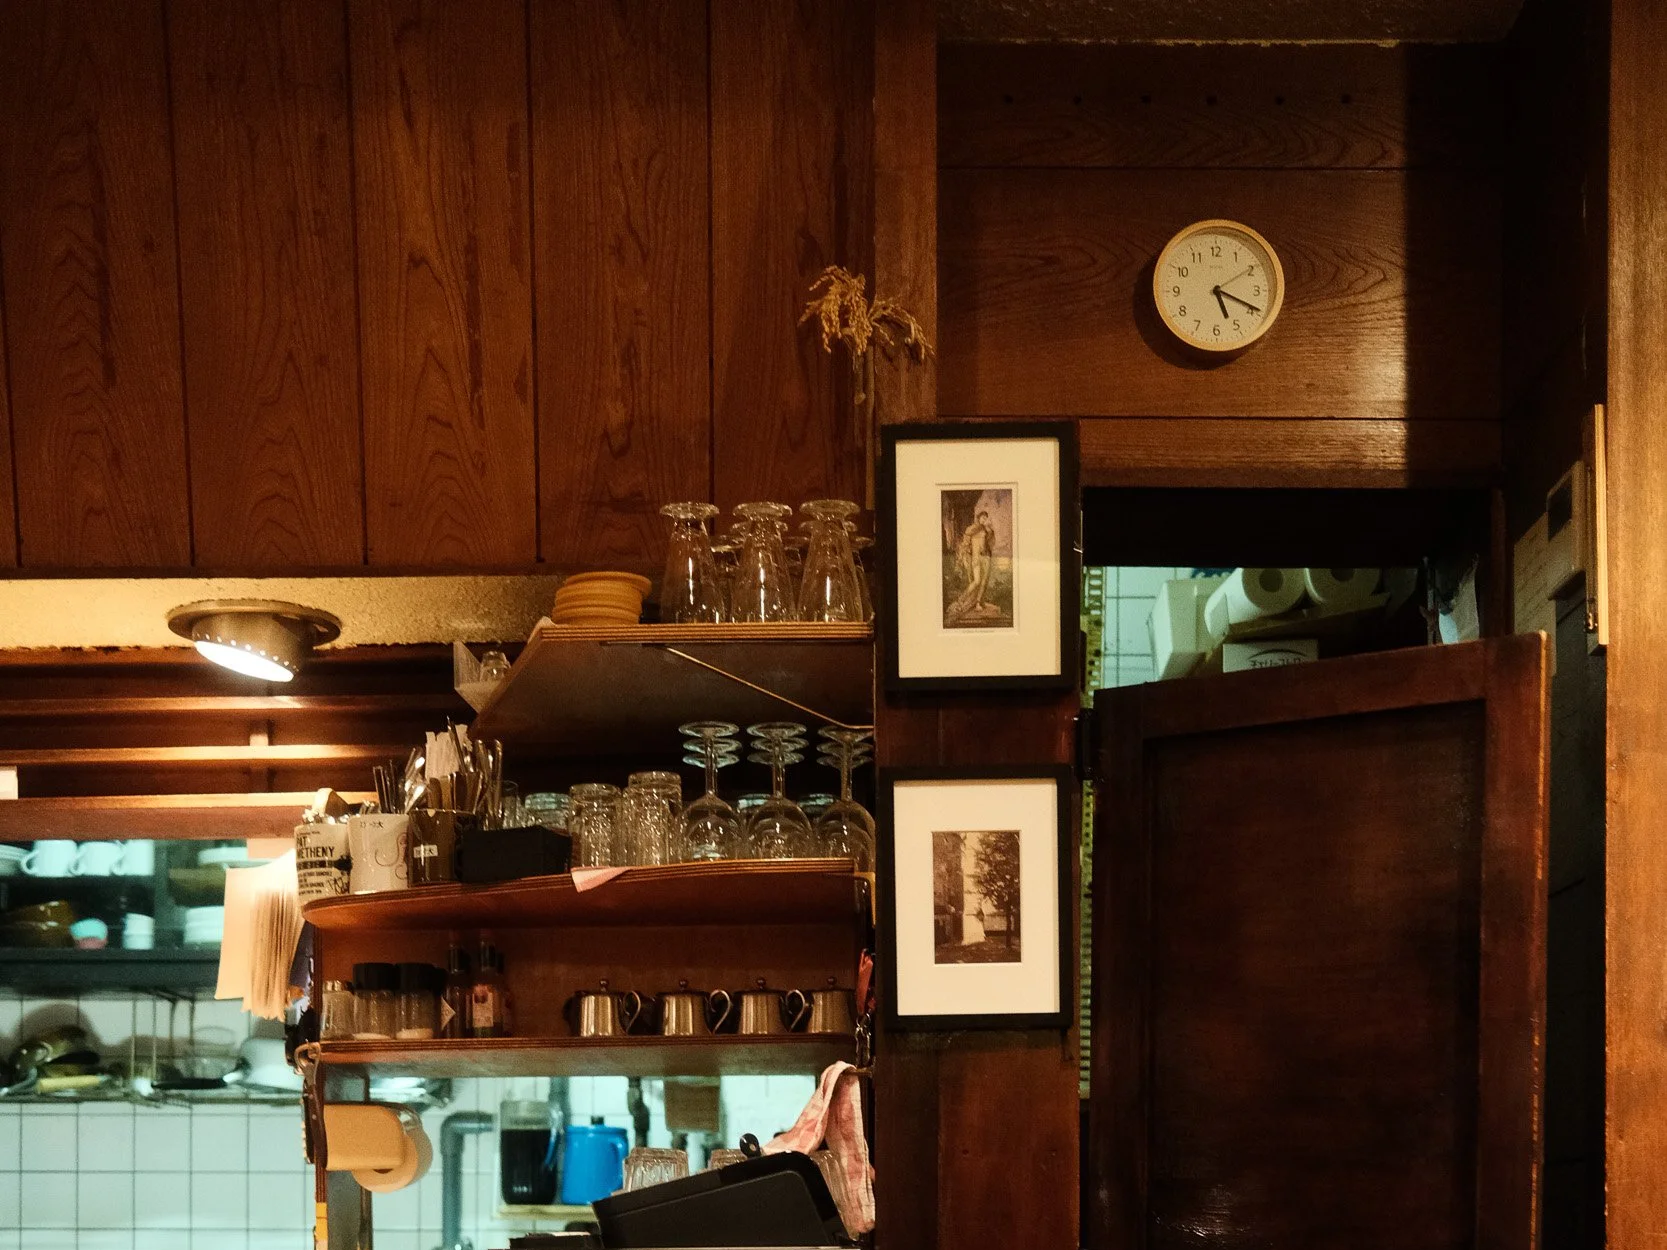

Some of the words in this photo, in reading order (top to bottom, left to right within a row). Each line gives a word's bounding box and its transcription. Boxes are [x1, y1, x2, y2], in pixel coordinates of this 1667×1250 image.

[1191, 252, 1202, 263] 11
[1210, 246, 1222, 258] 12
[1233, 251, 1238, 263] 1
[1178, 266, 1189, 278] 10
[1247, 265, 1255, 277] 2
[1172, 285, 1181, 297] 9
[1252, 285, 1261, 297] 3
[1178, 305, 1187, 317] 8
[1193, 319, 1201, 331] 7
[1212, 325, 1221, 336] 6
[1232, 319, 1240, 331] 5
